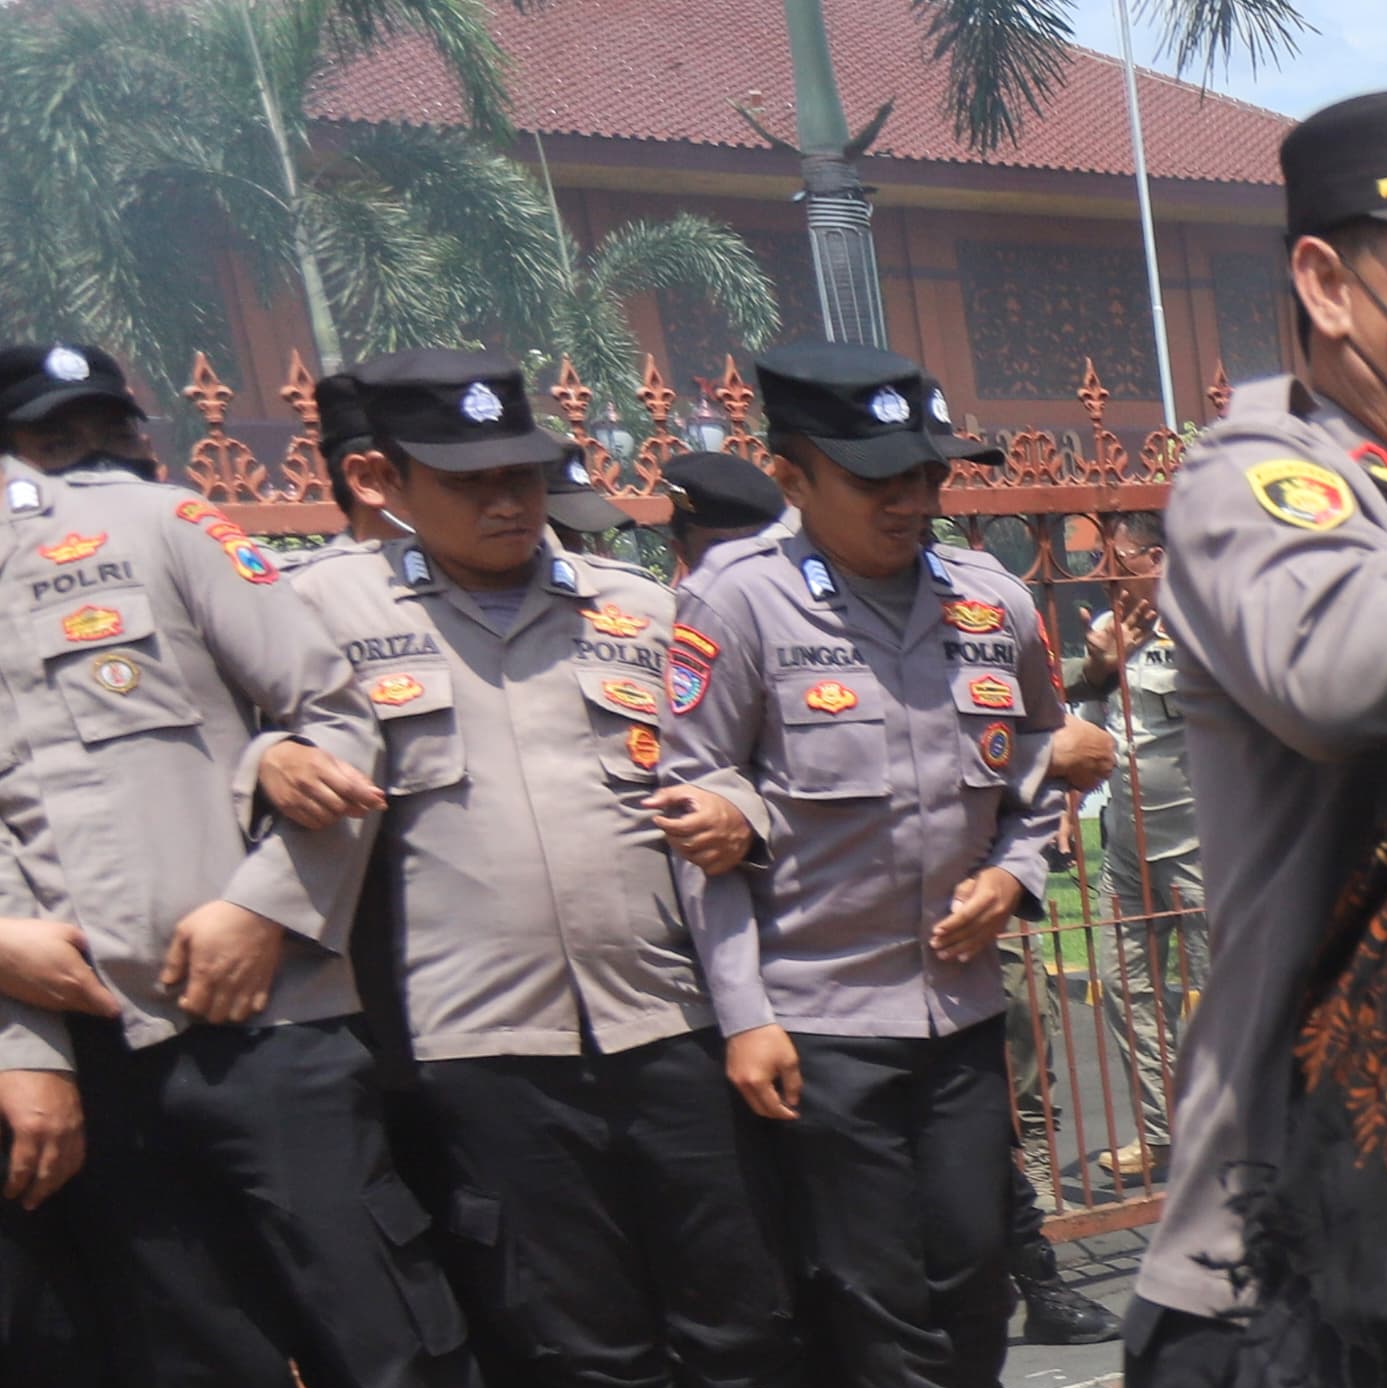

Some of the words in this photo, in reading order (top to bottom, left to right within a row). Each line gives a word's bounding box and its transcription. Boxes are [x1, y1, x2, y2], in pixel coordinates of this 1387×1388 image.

[32, 560, 133, 600] POLRI
[572, 637, 663, 674] POLRI
[776, 646, 866, 668] LINGGA
[943, 641, 1014, 664] POLRI
